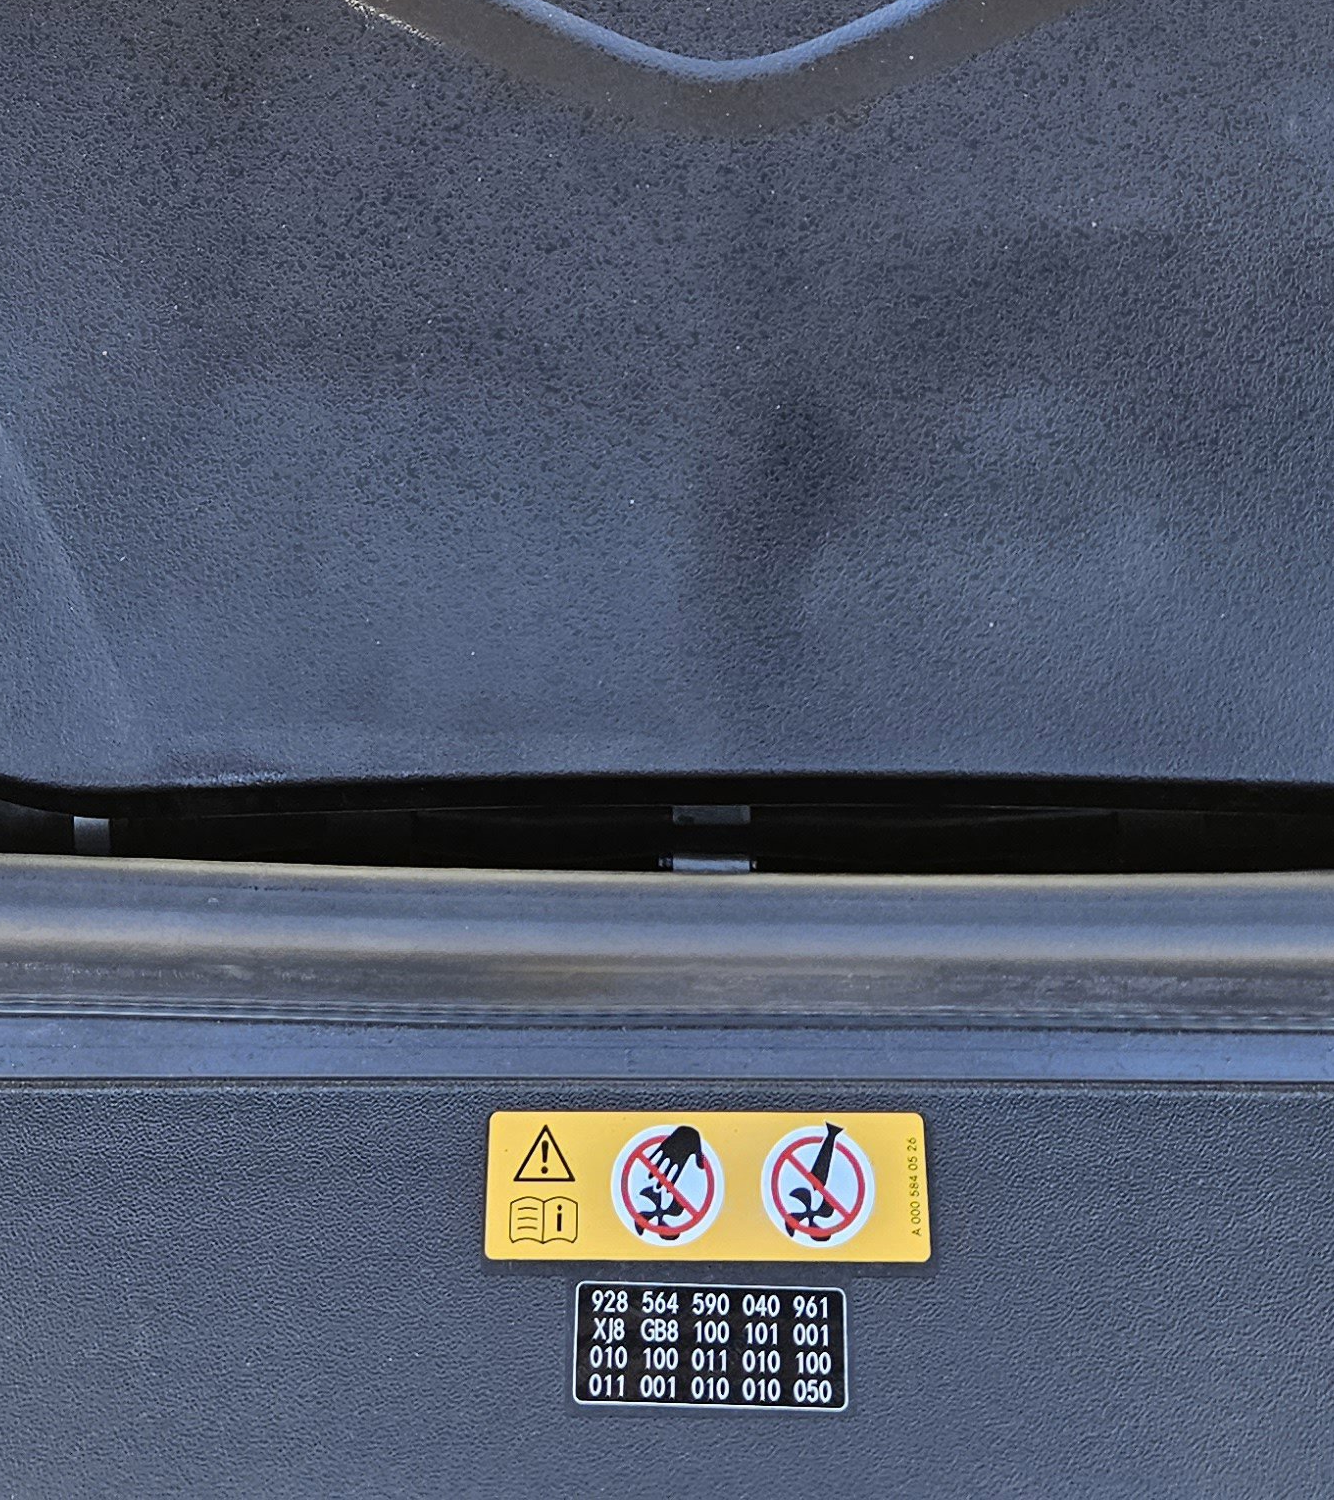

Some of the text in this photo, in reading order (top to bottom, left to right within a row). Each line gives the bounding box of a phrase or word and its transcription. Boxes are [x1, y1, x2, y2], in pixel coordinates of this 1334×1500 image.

[906, 1137, 922, 1237] A 000 584 05 26
[592, 1290, 828, 1319] 928 564 590 040 961
[593, 1317, 829, 1347] XJ8 GB8 100 101 001
[589, 1345, 831, 1375] 010 100 011 010 100
[589, 1374, 832, 1403] 011 001 010 010 050
